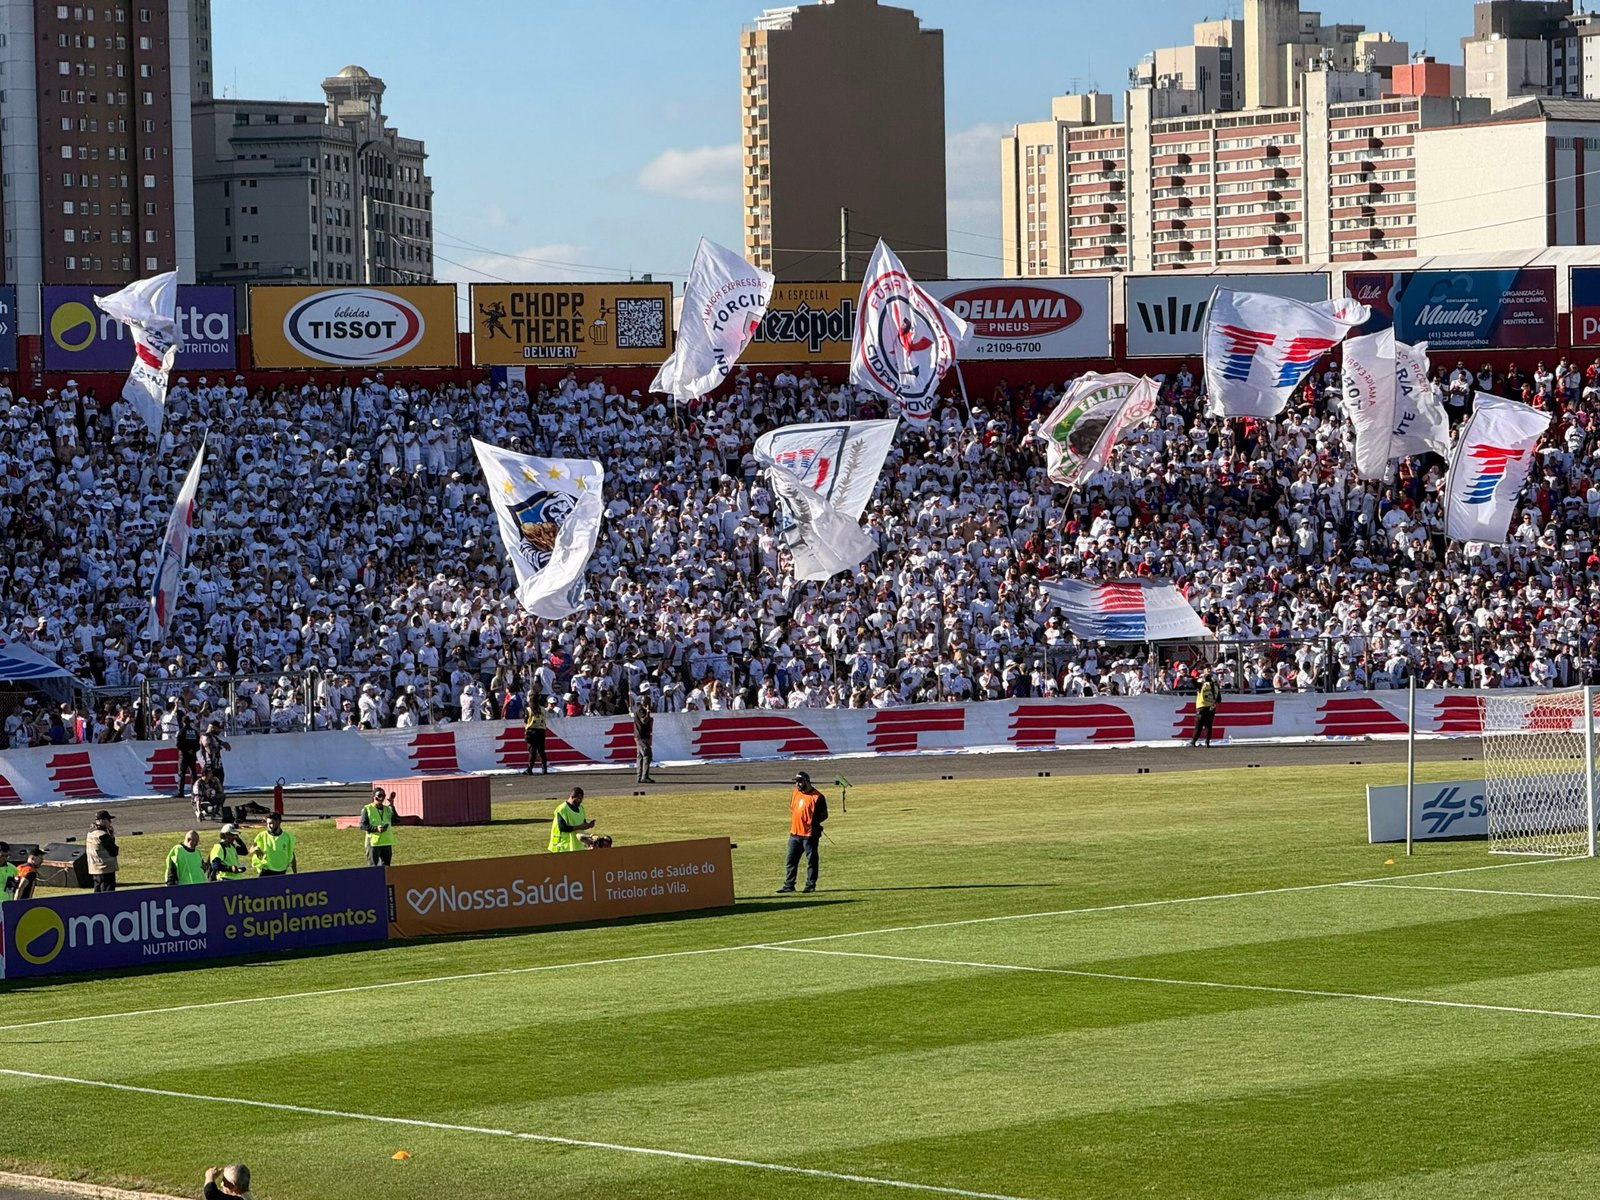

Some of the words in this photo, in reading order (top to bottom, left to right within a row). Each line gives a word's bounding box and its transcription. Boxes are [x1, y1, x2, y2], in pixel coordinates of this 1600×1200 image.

[788, 289, 830, 301] ESPECIAL
[1502, 289, 1545, 298] ORGANIZAÇÃO
[334, 306, 370, 319] bebidas
[510, 292, 585, 318] CHOPP
[712, 293, 769, 333] TORCID
[1414, 302, 1488, 327] Munhoz
[308, 321, 396, 340] TISSOT
[989, 322, 1030, 332] PNEUS
[1428, 331, 1441, 340] (41)
[522, 345, 578, 359] DELIVERY
[986, 342, 1042, 353] 2109-6700
[1078, 385, 1130, 412] FALAN
[605, 871, 615, 884] O
[617, 868, 648, 883] Plano
[650, 866, 664, 880] de
[666, 862, 699, 878] Saúde
[701, 861, 716, 874] do
[606, 886, 648, 901] Tricolor
[650, 883, 665, 897] da
[667, 881, 690, 895] Vila.
[223, 888, 330, 917] Vitaminas
[68, 899, 208, 948] maltta
[224, 923, 237, 940] e
[243, 906, 378, 941] Suplementos
[142, 937, 208, 956] NUTRITION
